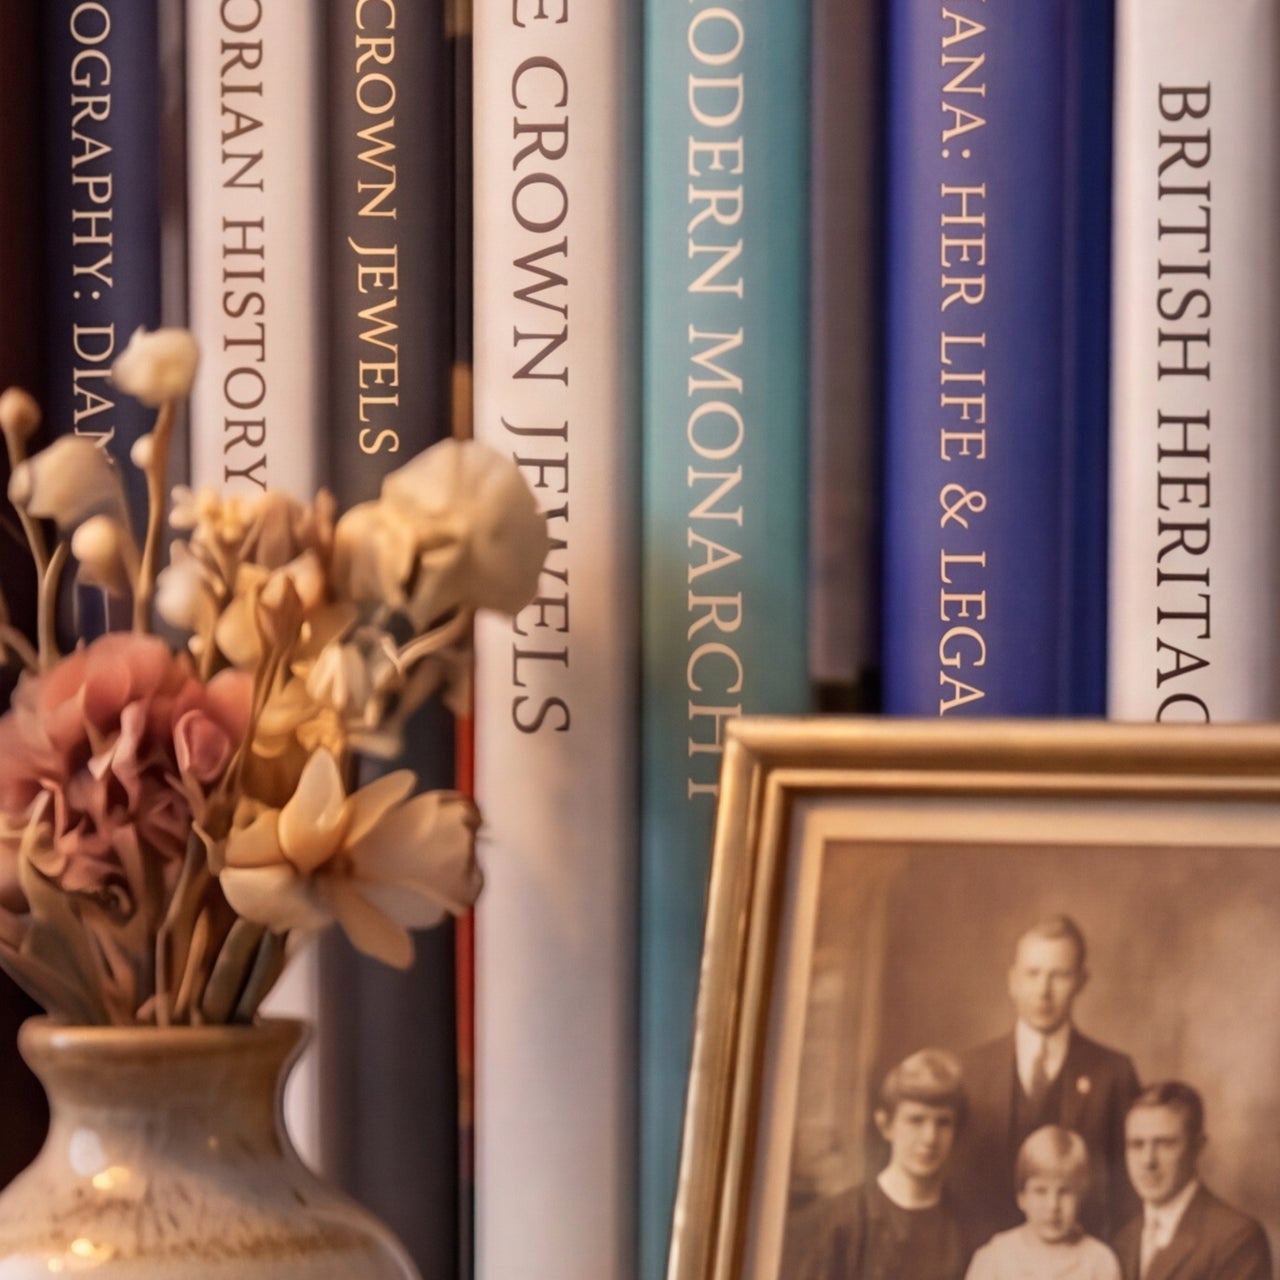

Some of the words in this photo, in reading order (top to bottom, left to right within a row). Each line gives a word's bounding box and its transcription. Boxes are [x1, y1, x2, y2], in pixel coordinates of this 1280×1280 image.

[510, 55, 570, 387] CROWN
[940, 181, 987, 313] HER
[1155, 80, 1212, 382] BRITISH
[221, 216, 268, 493] HISTORY
[348, 235, 399, 455] JEWELS
[940, 330, 987, 462] LIFE
[939, 482, 988, 529] &
